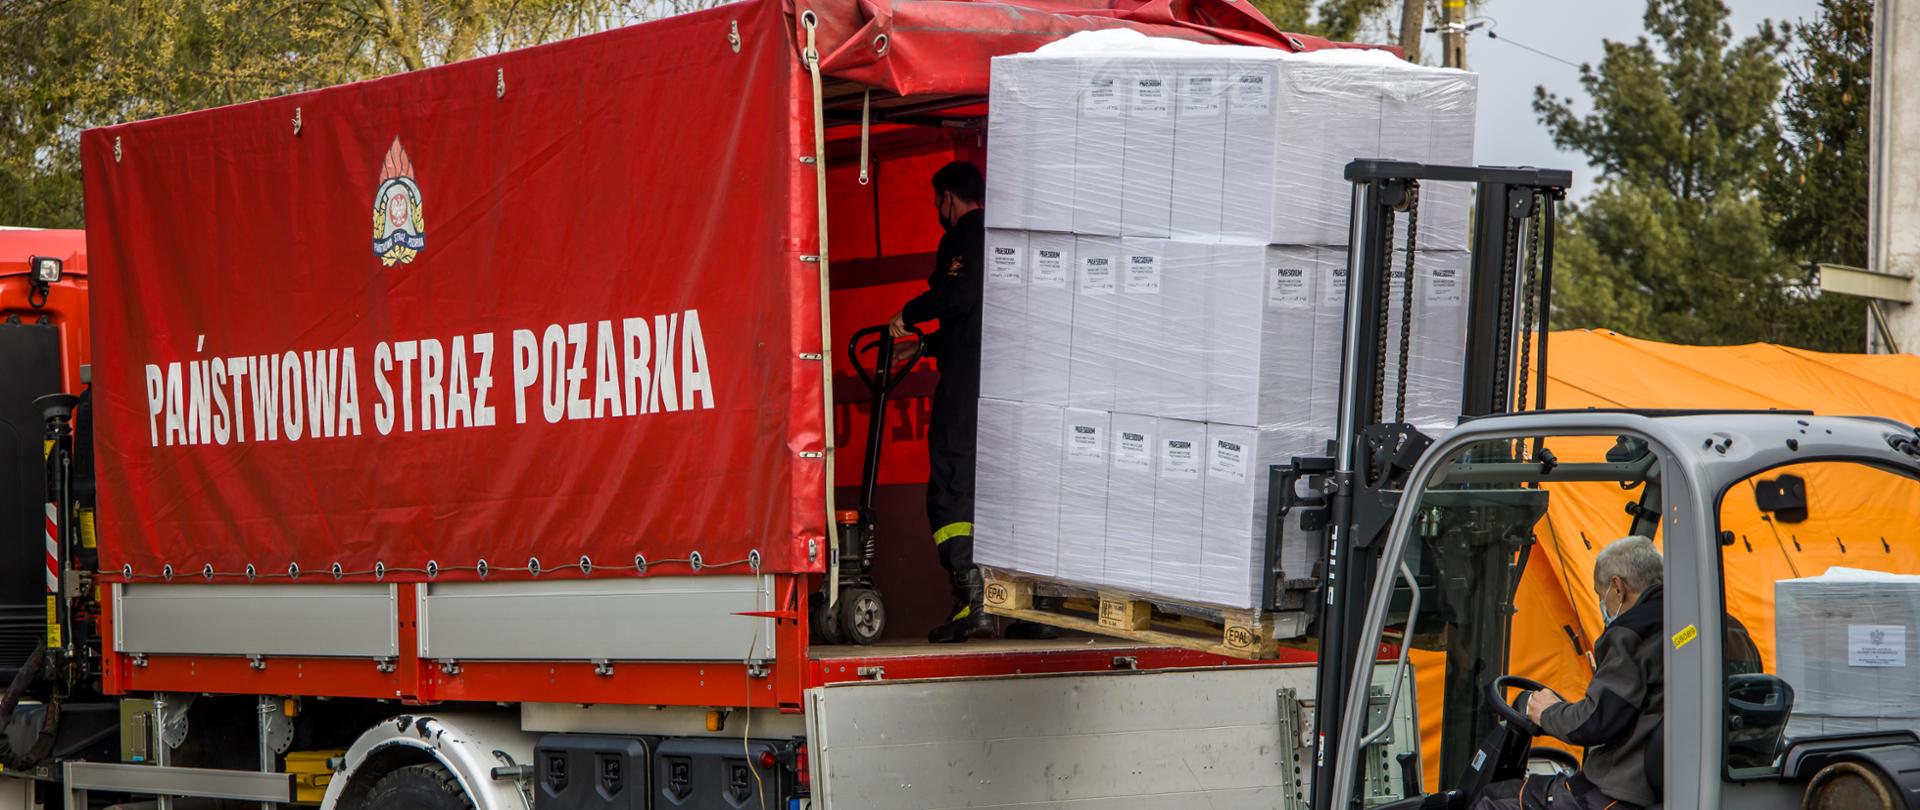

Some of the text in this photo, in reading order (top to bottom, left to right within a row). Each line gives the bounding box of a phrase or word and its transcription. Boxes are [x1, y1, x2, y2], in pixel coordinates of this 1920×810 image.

[145, 334, 362, 447] PAŃSTWOWA
[373, 332, 496, 436] STRAŻ
[987, 586, 1005, 600] EPAL
[1228, 629, 1249, 644] EPAL
[1674, 627, 1696, 646] G8089
